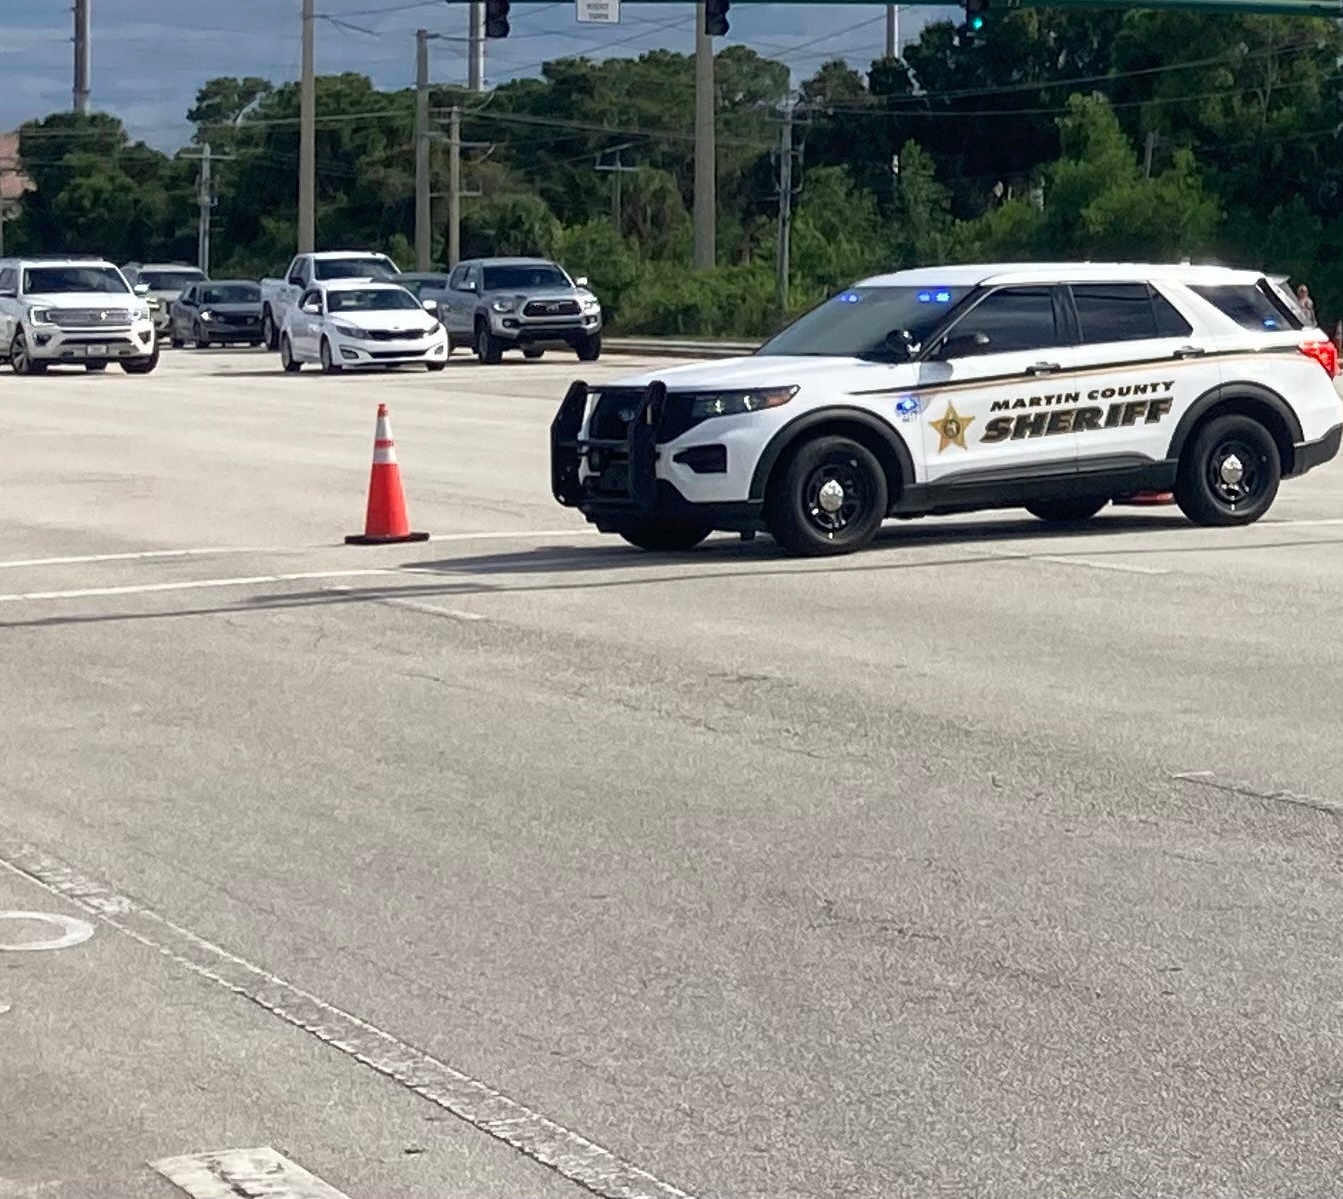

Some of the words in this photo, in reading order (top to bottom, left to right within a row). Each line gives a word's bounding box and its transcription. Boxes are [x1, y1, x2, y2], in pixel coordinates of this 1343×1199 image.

[990, 392, 1080, 412] MARTIN
[1087, 380, 1175, 400] COUNTY
[979, 397, 1174, 444] SHERIFF
